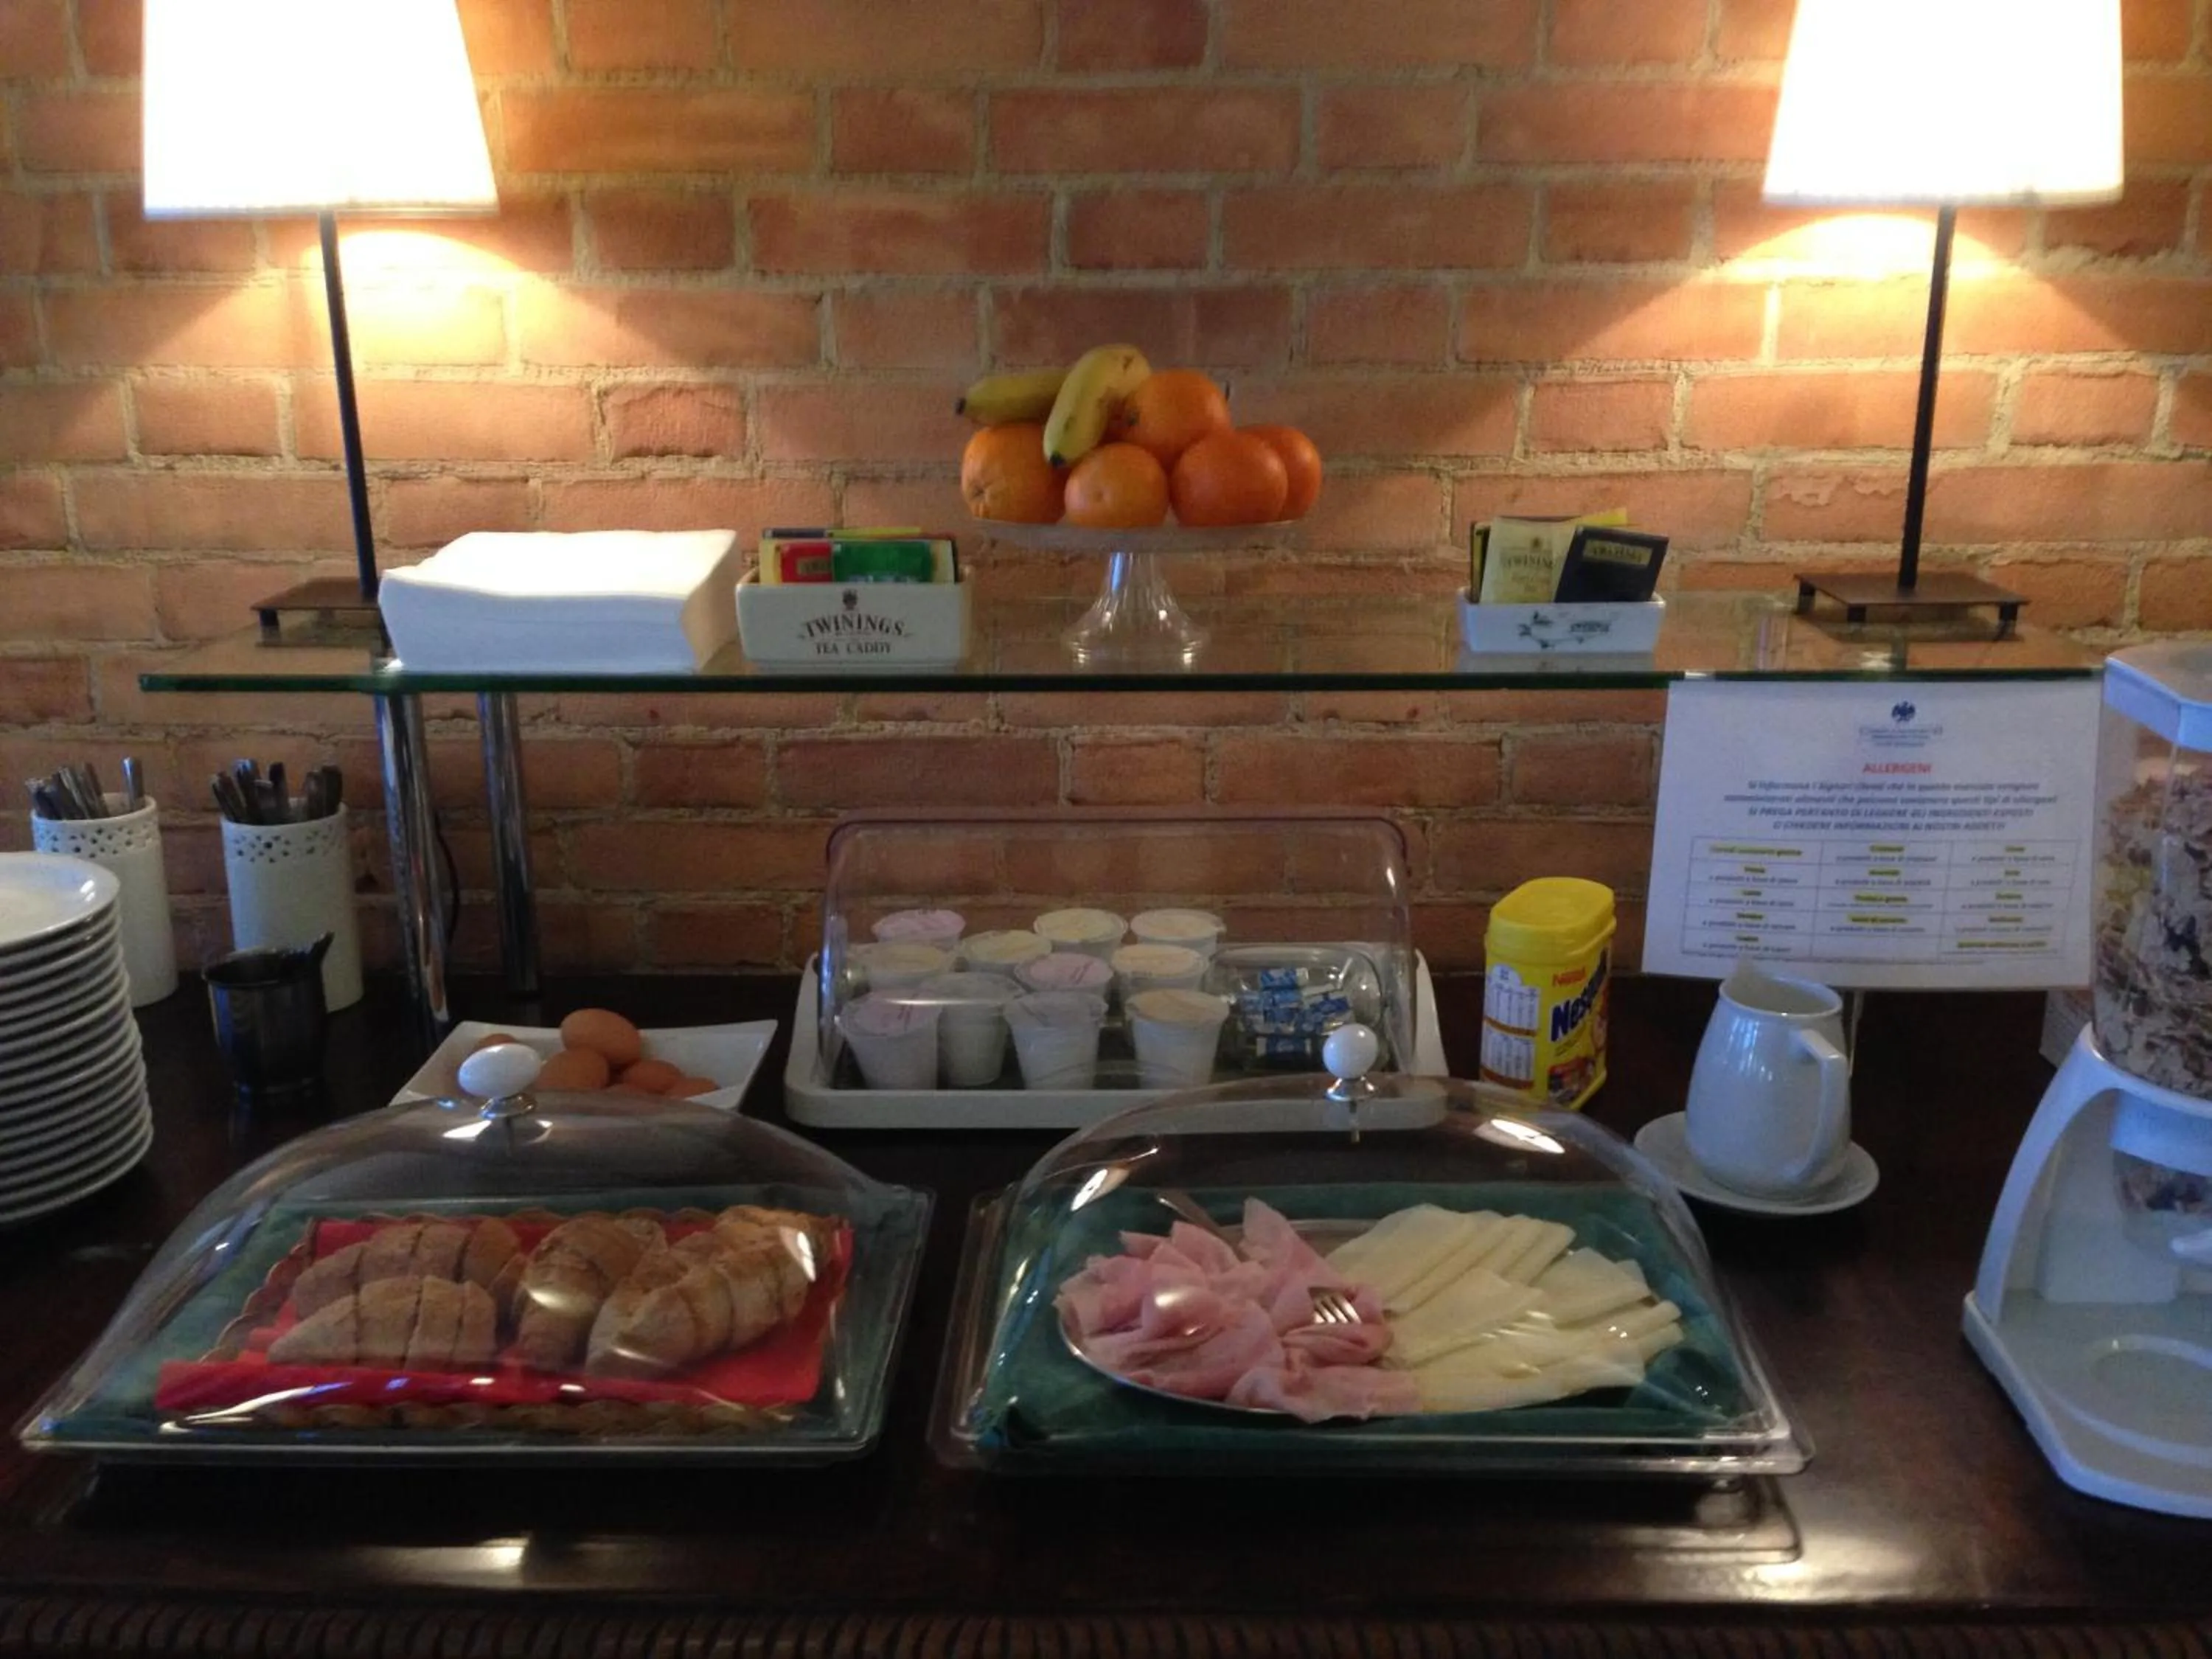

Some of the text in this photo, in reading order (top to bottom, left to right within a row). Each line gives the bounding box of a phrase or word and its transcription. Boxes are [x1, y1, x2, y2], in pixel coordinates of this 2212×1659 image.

[801, 613, 906, 637] TWININGS
[815, 641, 891, 655] TEA CADDY
